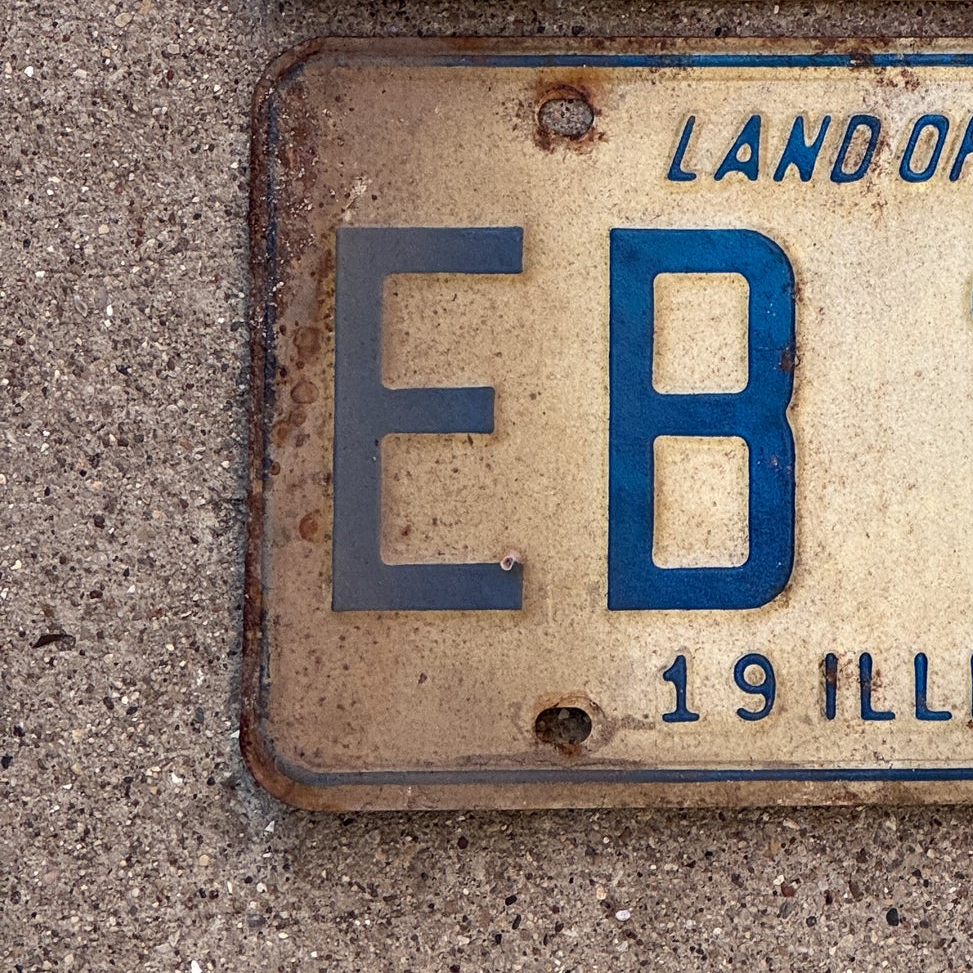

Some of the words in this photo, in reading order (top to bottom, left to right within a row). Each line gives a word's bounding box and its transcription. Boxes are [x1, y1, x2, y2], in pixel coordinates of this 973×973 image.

[667, 114, 881, 184] LAND
[332, 226, 796, 611] EB
[662, 652, 776, 723] 19
